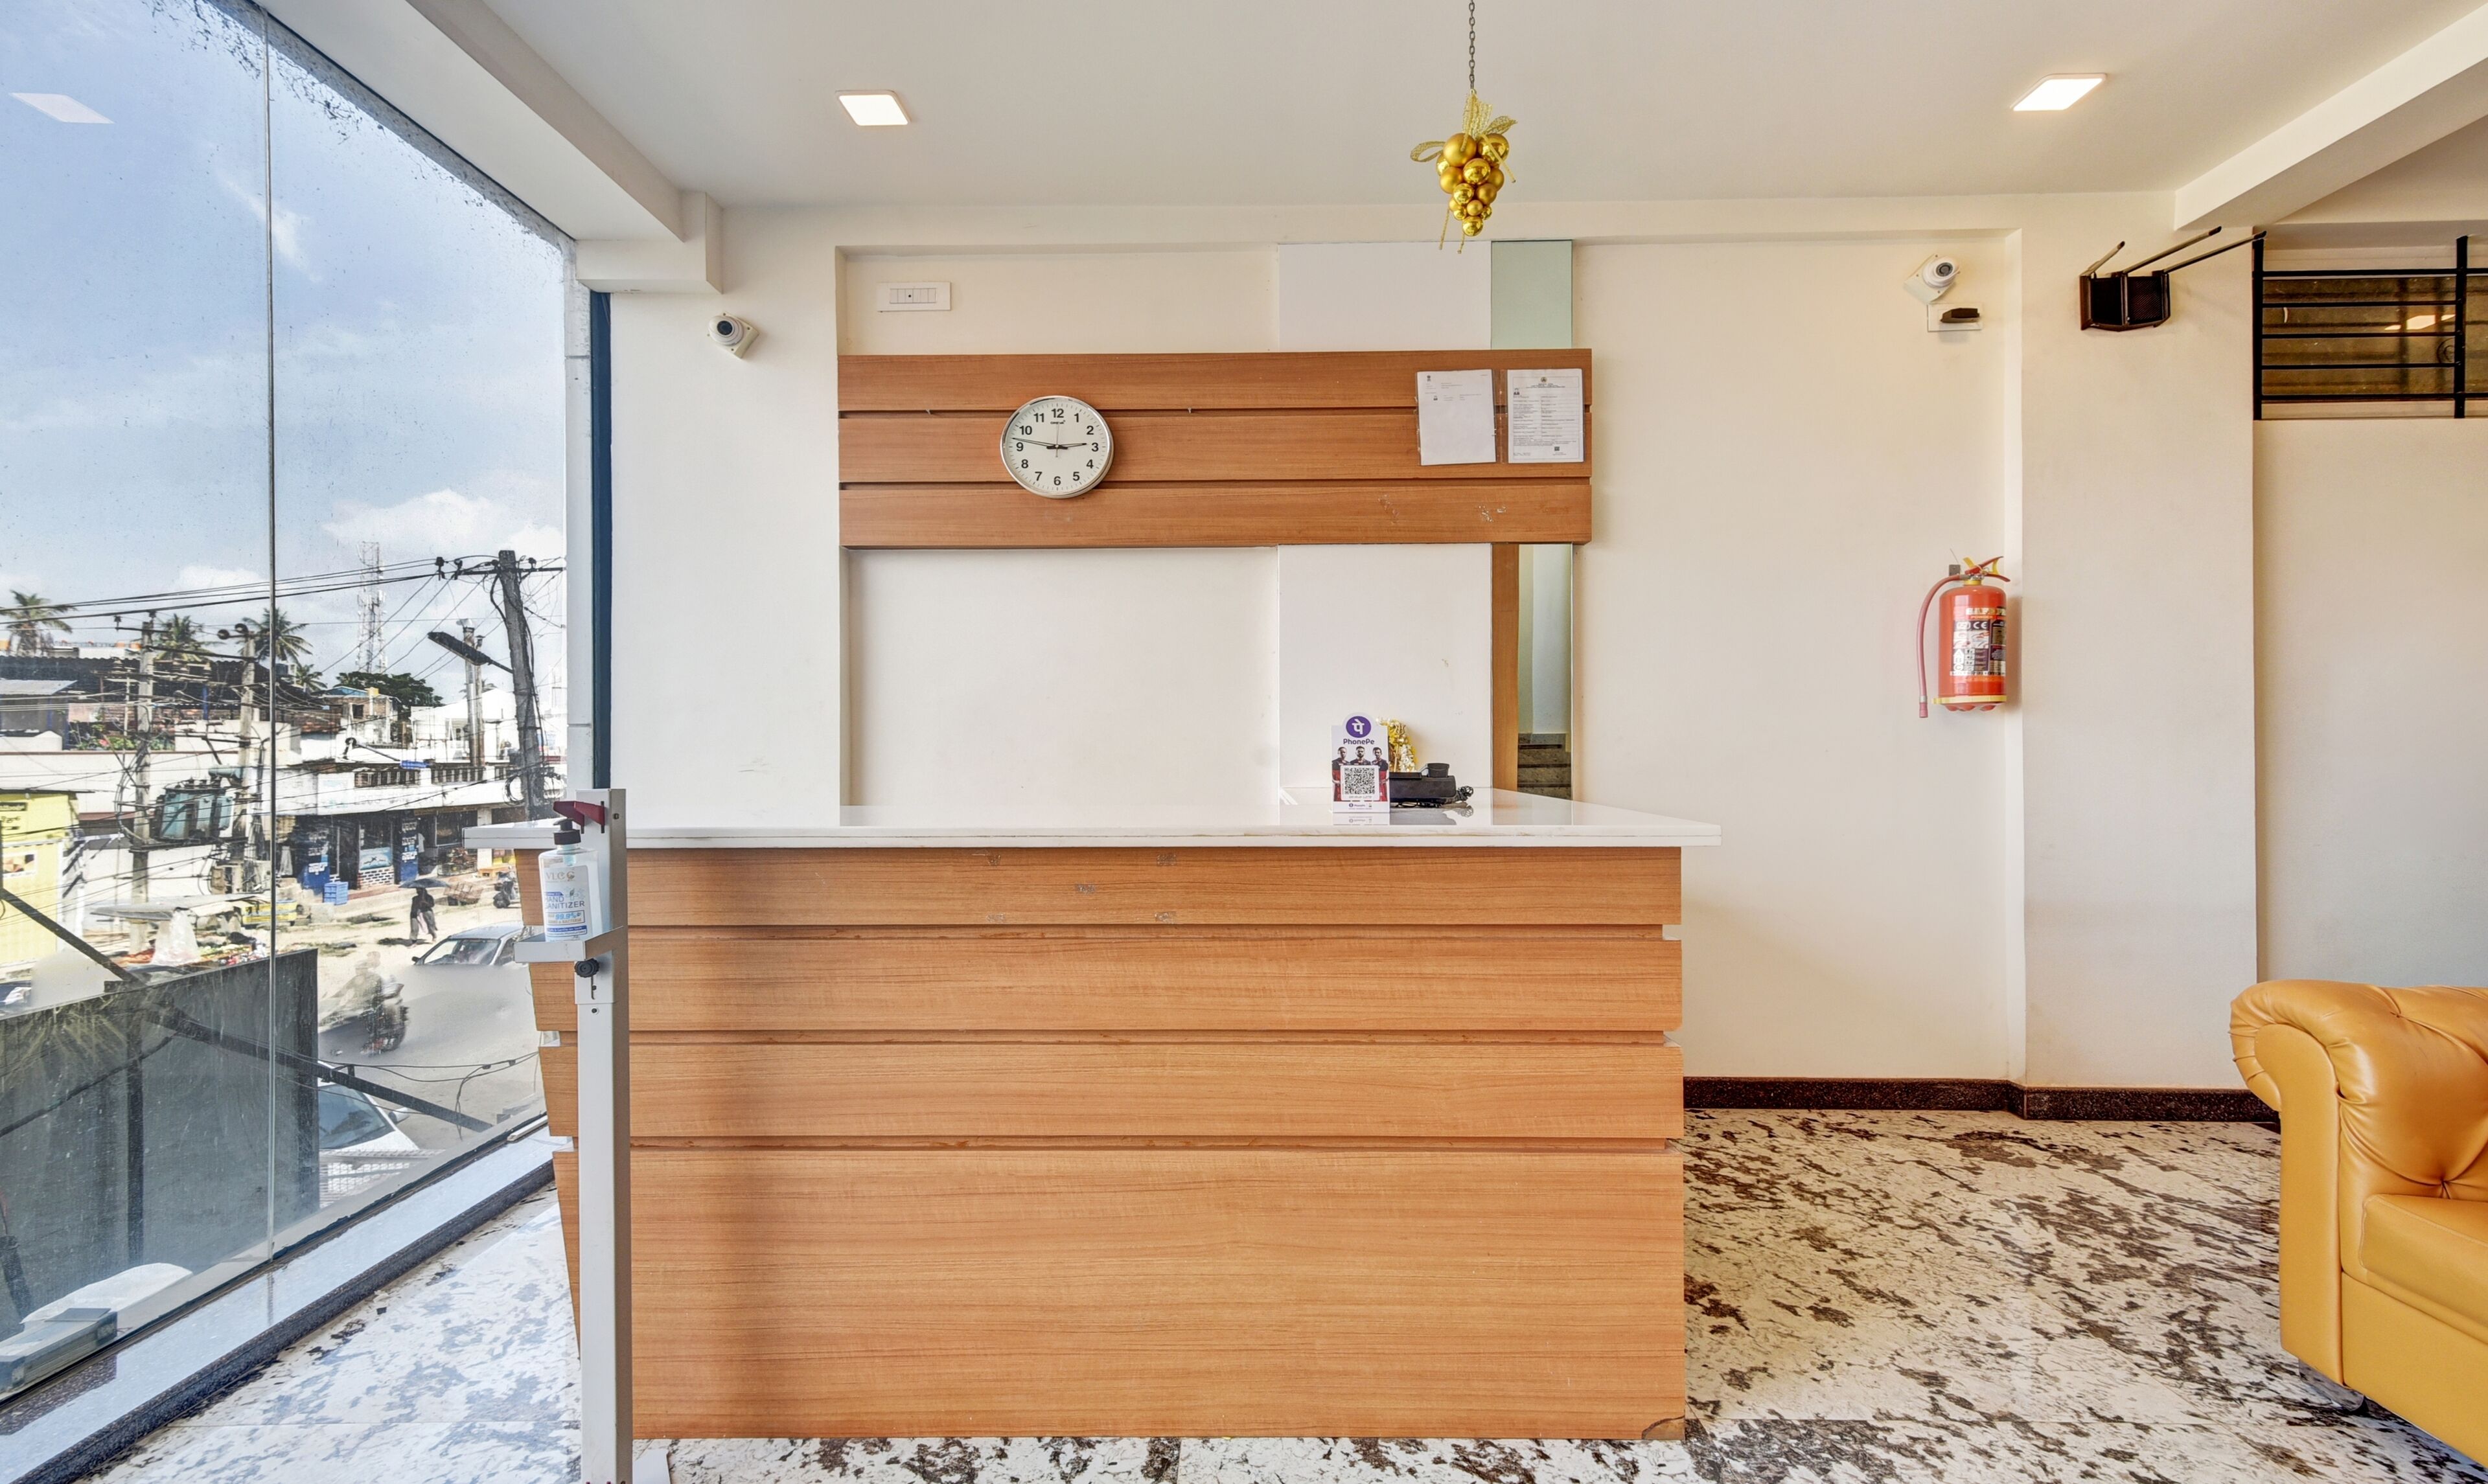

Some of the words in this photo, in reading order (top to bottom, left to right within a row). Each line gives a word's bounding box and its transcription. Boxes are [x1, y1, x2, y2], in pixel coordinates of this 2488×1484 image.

[1034, 413, 1044, 422] 11
[1052, 409, 1064, 418] 12
[1074, 413, 1079, 422] 1
[1019, 426, 1032, 435] 10
[1087, 426, 1094, 435] 2
[1017, 442, 1024, 451] 9
[1092, 442, 1099, 451] 3
[1021, 459, 1028, 468] 8
[1087, 459, 1094, 468] 4
[1035, 472, 1042, 481] 7
[1054, 476, 1061, 485] 6
[1073, 472, 1080, 481] 5
